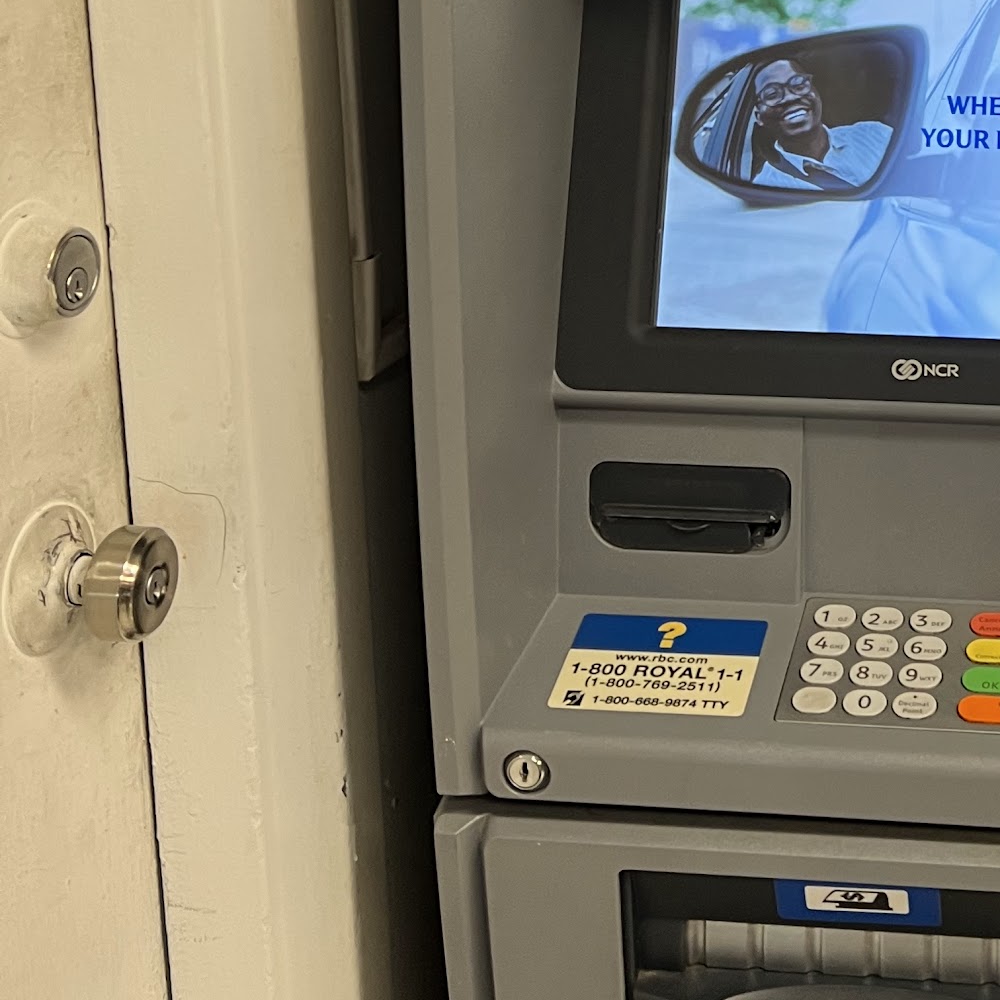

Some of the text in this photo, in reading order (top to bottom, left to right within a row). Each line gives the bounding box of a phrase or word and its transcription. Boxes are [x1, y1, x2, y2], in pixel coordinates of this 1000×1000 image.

[921, 128, 989, 150] YOUR
[923, 363, 959, 378] NCR
[822, 610, 830, 622] 1
[868, 613, 880, 625] 2
[915, 615, 928, 627] 3
[815, 637, 828, 649] 4
[861, 639, 875, 651] 5
[910, 642, 923, 654] 6
[616, 653, 708, 665] www.rbc.com
[571, 662, 627, 677] 1-800
[718, 669, 743, 681] 1-1
[808, 662, 822, 676] 7
[856, 666, 869, 679] 8
[905, 668, 918, 681] 9
[585, 676, 721, 693] (1-800-769-2511)
[981, 681, 1000, 690] OK
[592, 695, 729, 710] 1-800-668-9874 TTY
[858, 695, 871, 709] 0
